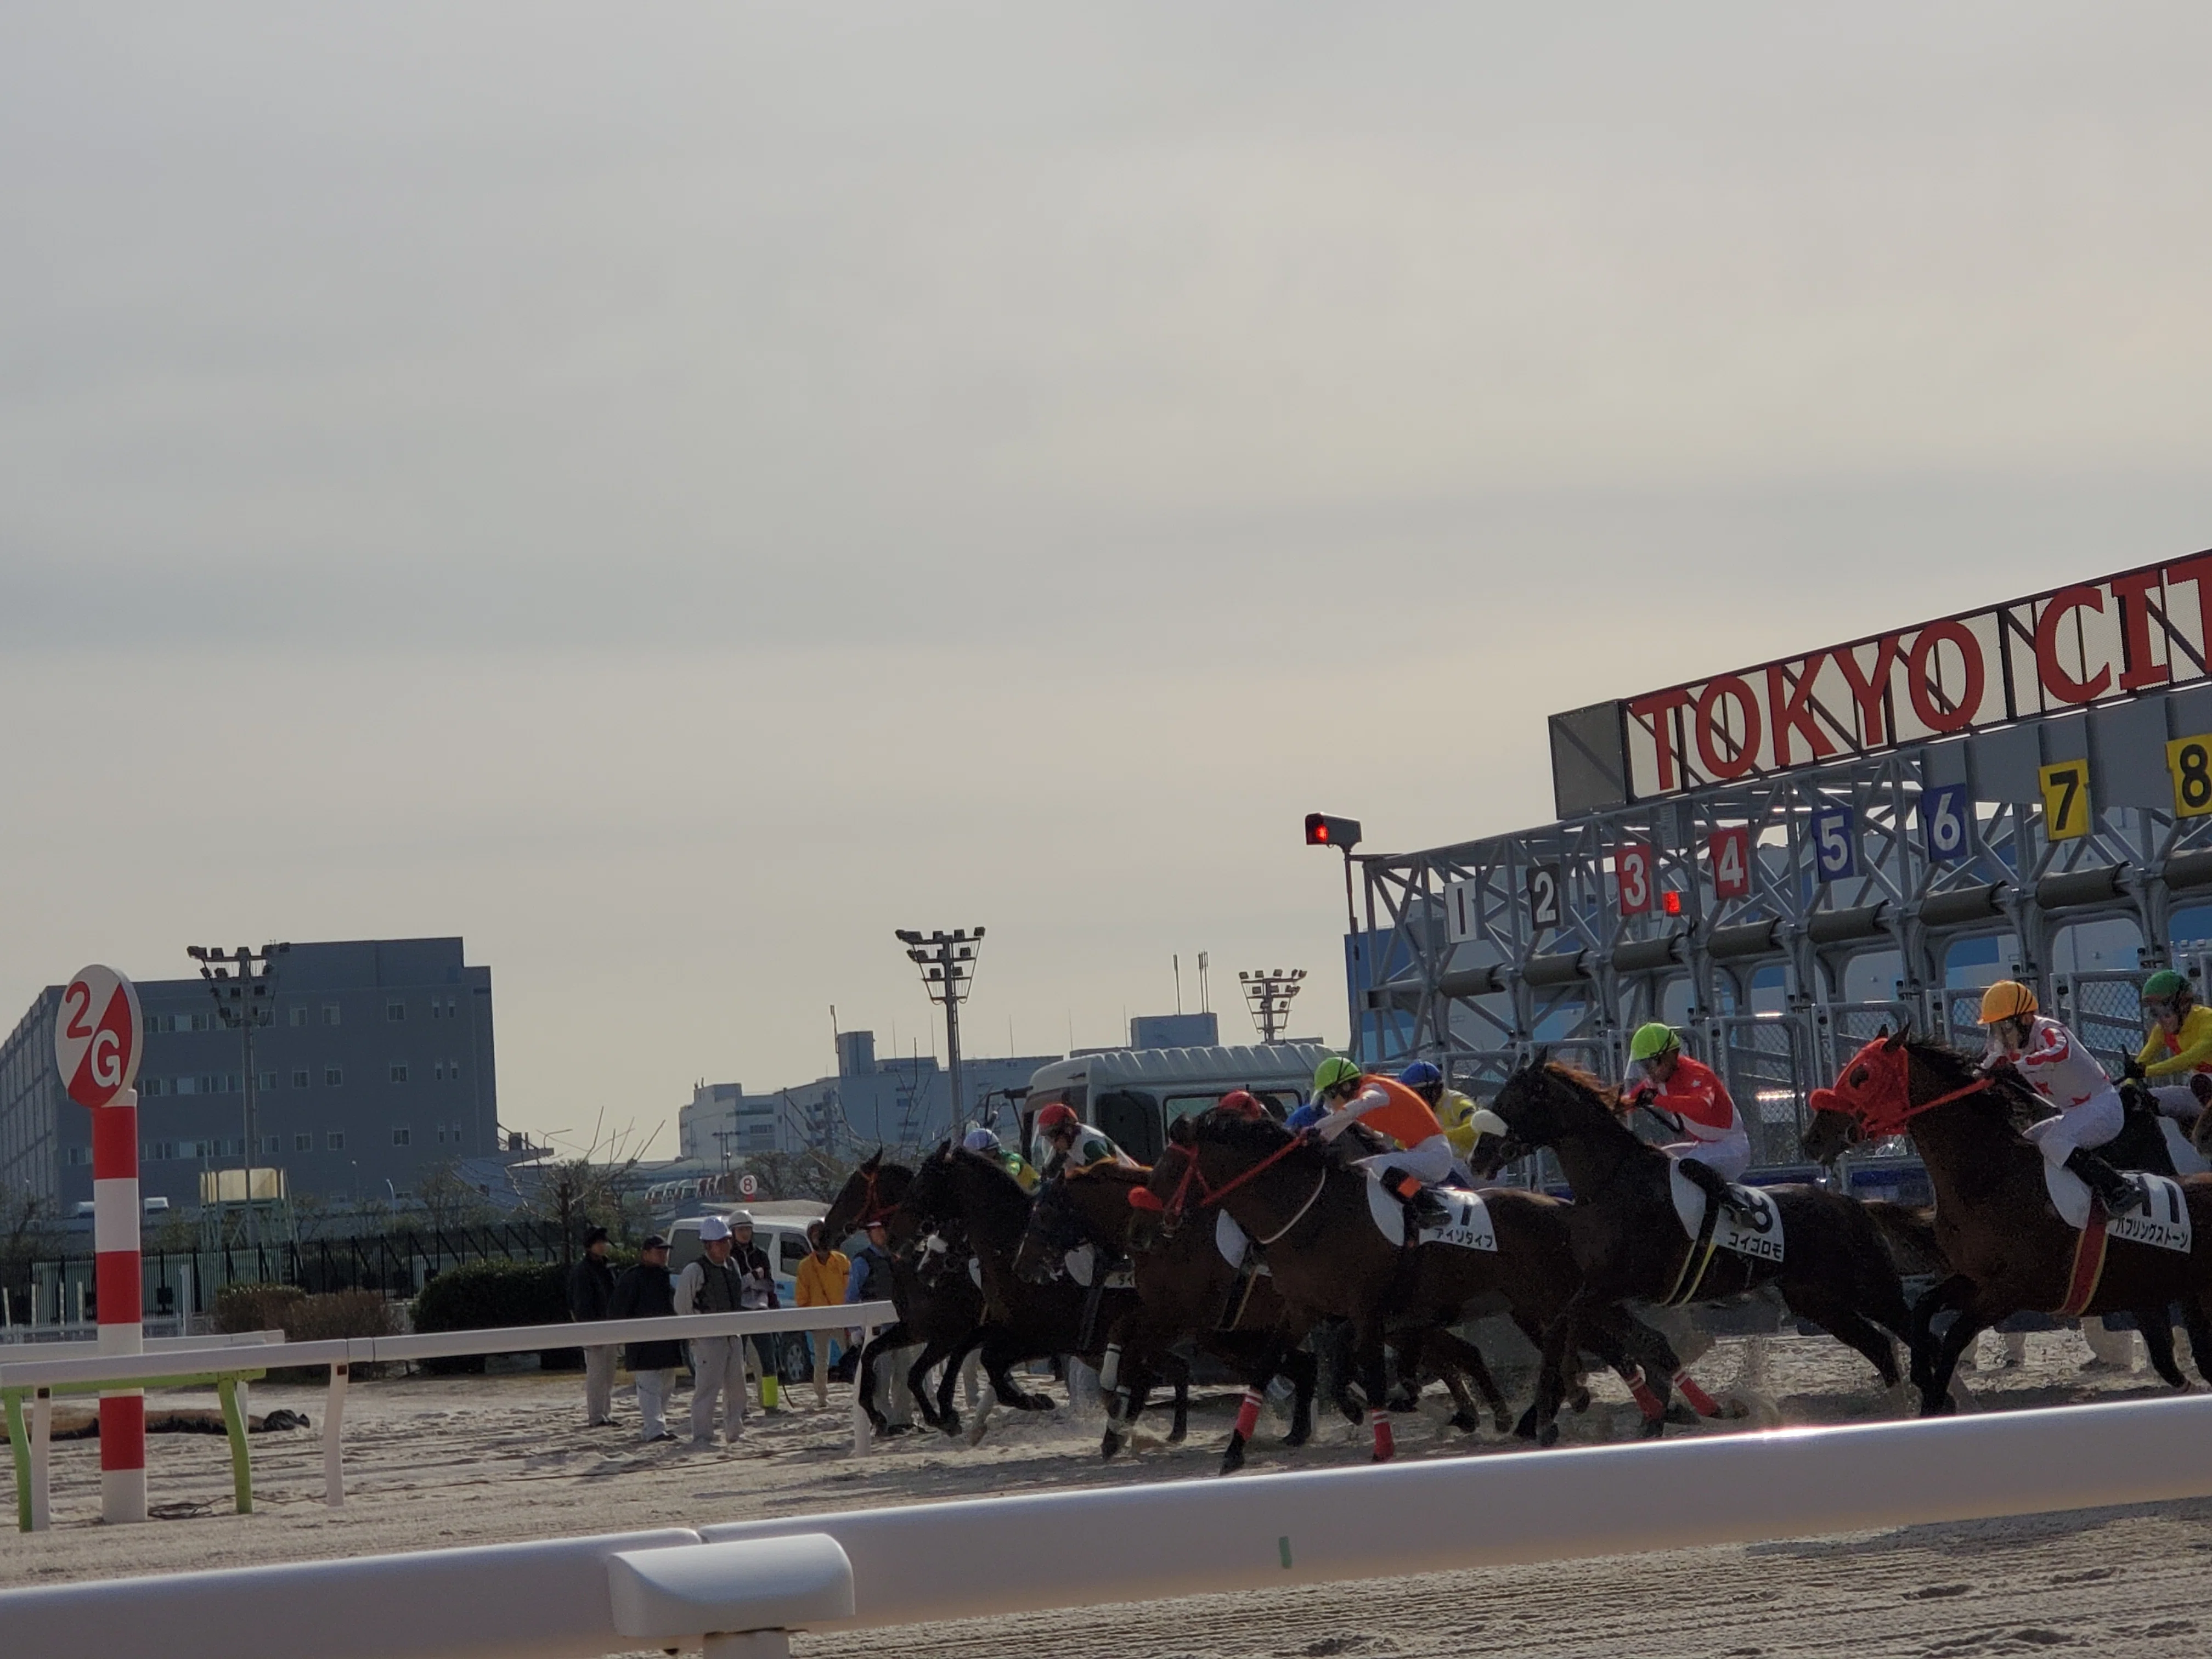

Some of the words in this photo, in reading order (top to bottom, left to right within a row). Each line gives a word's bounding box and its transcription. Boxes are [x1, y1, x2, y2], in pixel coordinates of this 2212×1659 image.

[1630, 620, 1984, 791] TOKYO
[2050, 770, 2079, 831] 7
[2180, 744, 2209, 808] 8
[1820, 815, 1848, 871] 5
[1933, 793, 1960, 851] 6
[1624, 853, 1646, 907] 3
[1719, 836, 1743, 888] 4
[1457, 888, 1466, 935] 1
[1534, 871, 1556, 923] 2
[65, 981, 92, 1039] 2
[91, 1029, 121, 1087] G
[743, 1178, 752, 1192] 8
[2136, 1176, 2180, 1224] 11
